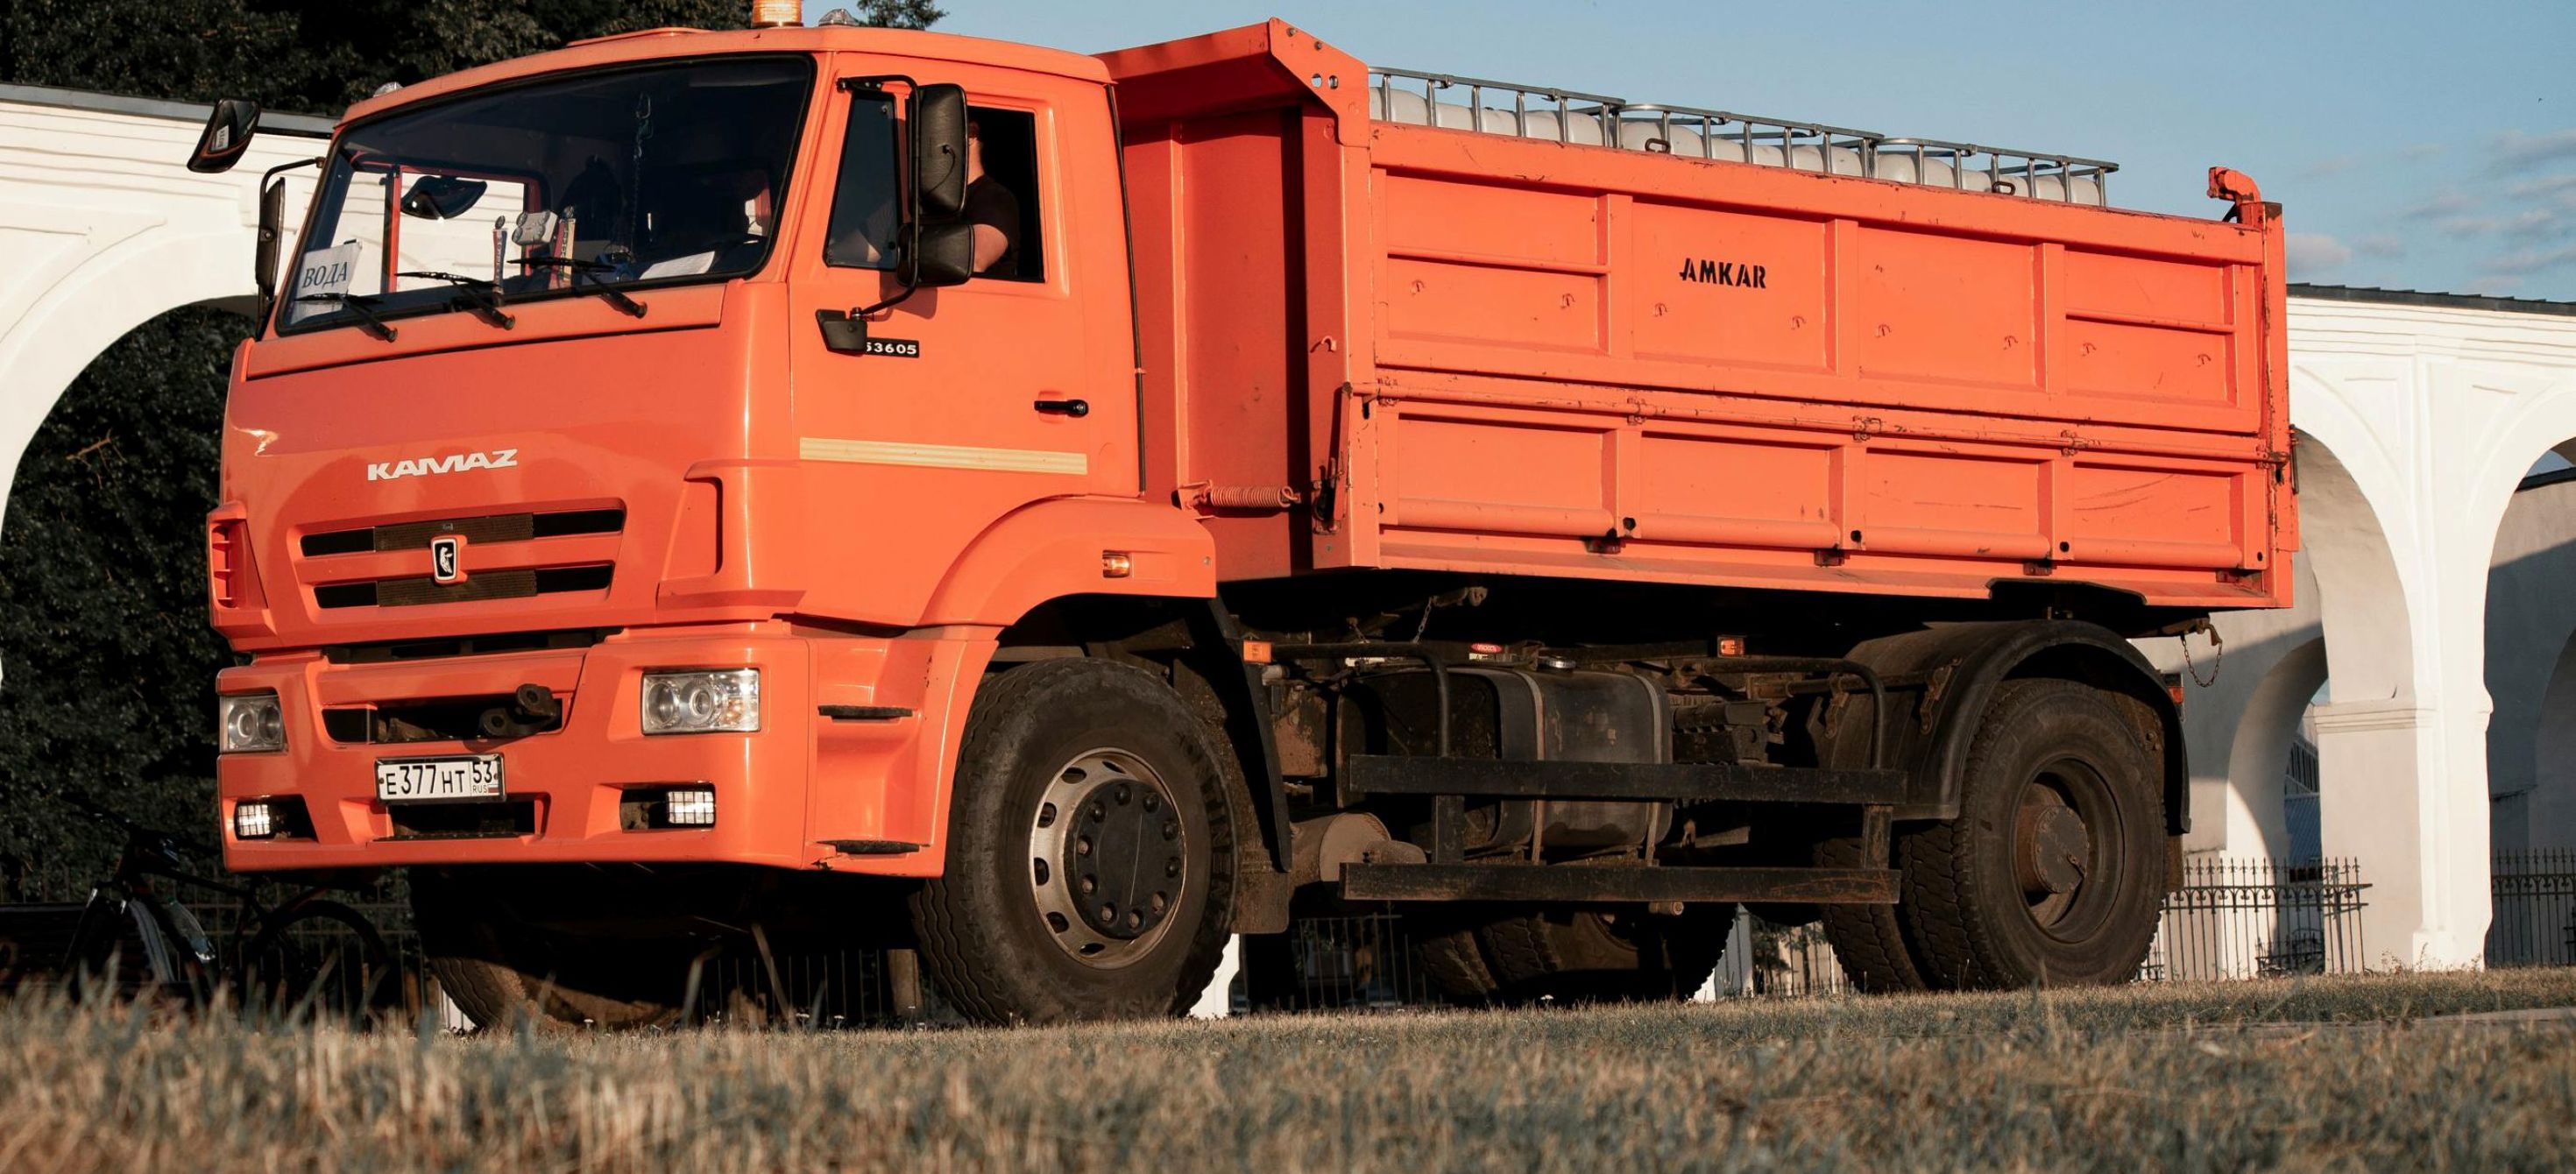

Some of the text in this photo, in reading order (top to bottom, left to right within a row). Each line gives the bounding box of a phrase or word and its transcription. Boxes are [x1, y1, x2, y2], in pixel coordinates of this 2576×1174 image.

[301, 261, 348, 290] ВОДА
[1679, 258, 1766, 289] AMKAR
[367, 449, 518, 481] KAMAZ
[472, 760, 492, 784] 53
[472, 785, 488, 794] RUS
